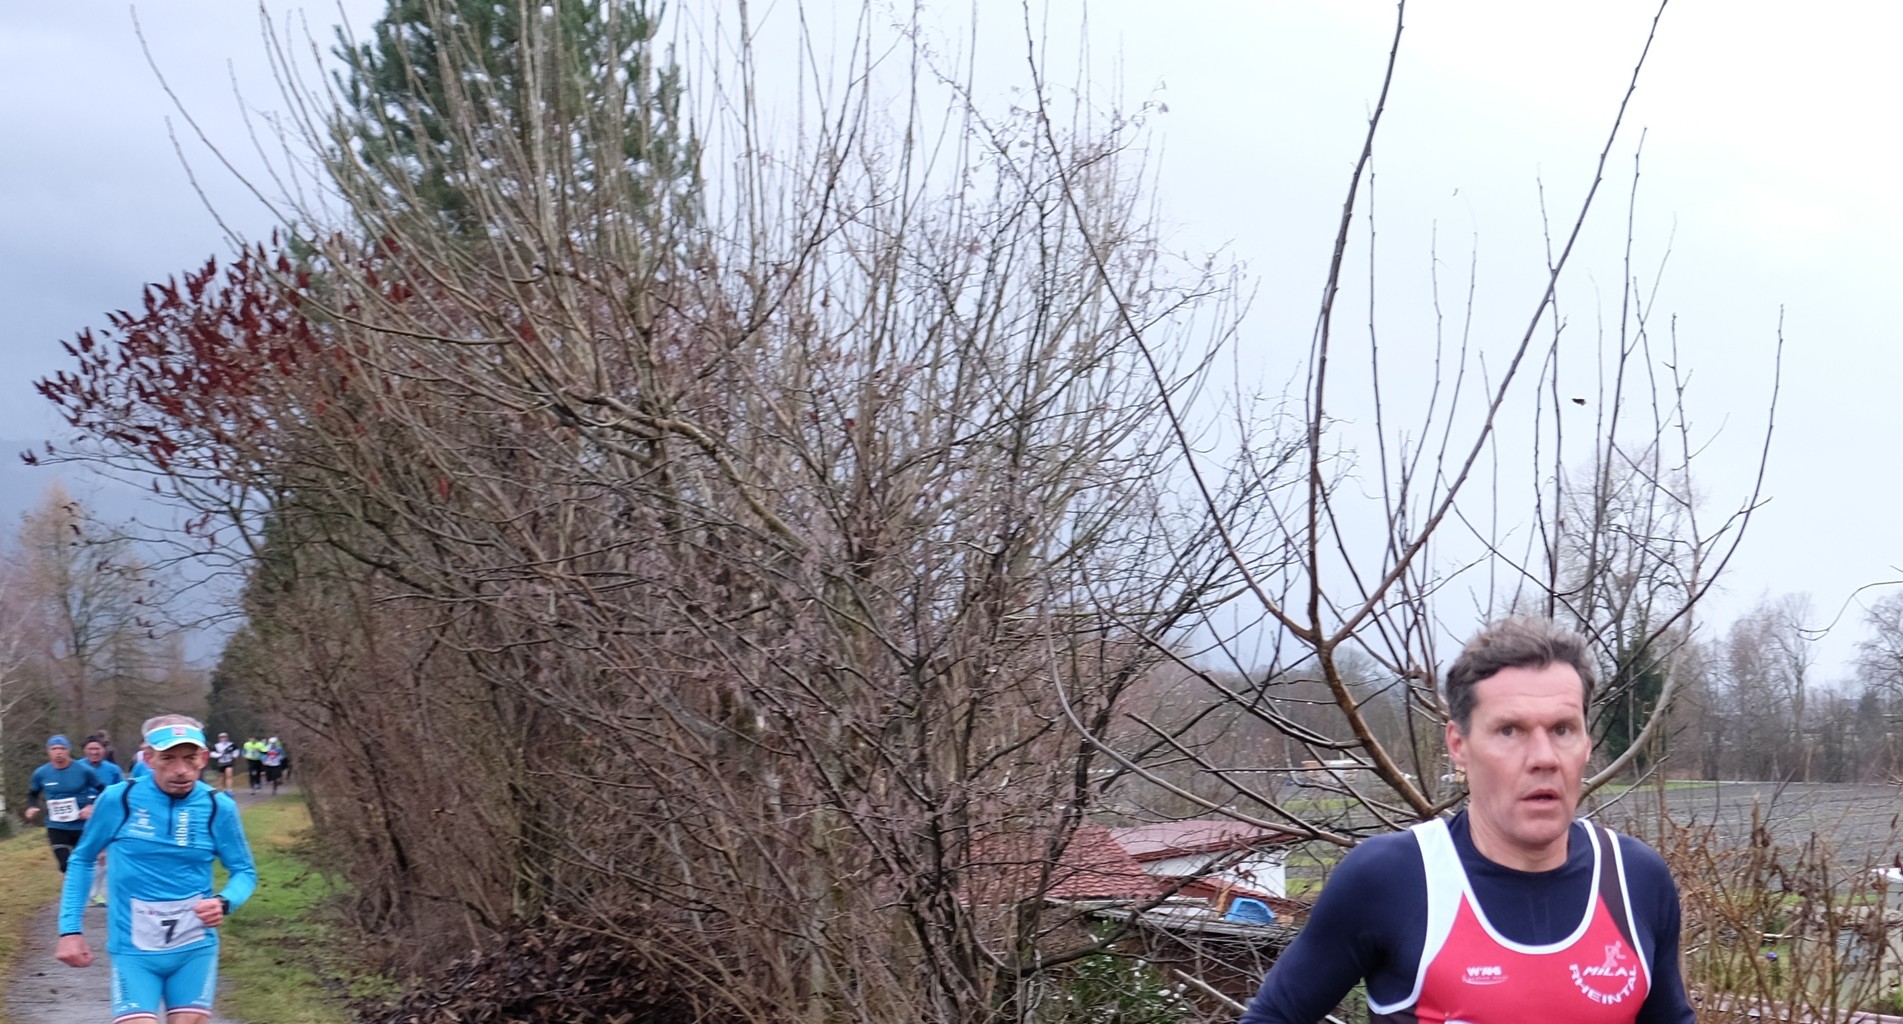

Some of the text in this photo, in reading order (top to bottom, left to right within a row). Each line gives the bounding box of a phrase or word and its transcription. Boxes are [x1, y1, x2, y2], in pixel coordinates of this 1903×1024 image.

[161, 919, 179, 944] 7
[1569, 963, 1637, 1004] RHEINTAL
[1582, 966, 1629, 977] MILA
